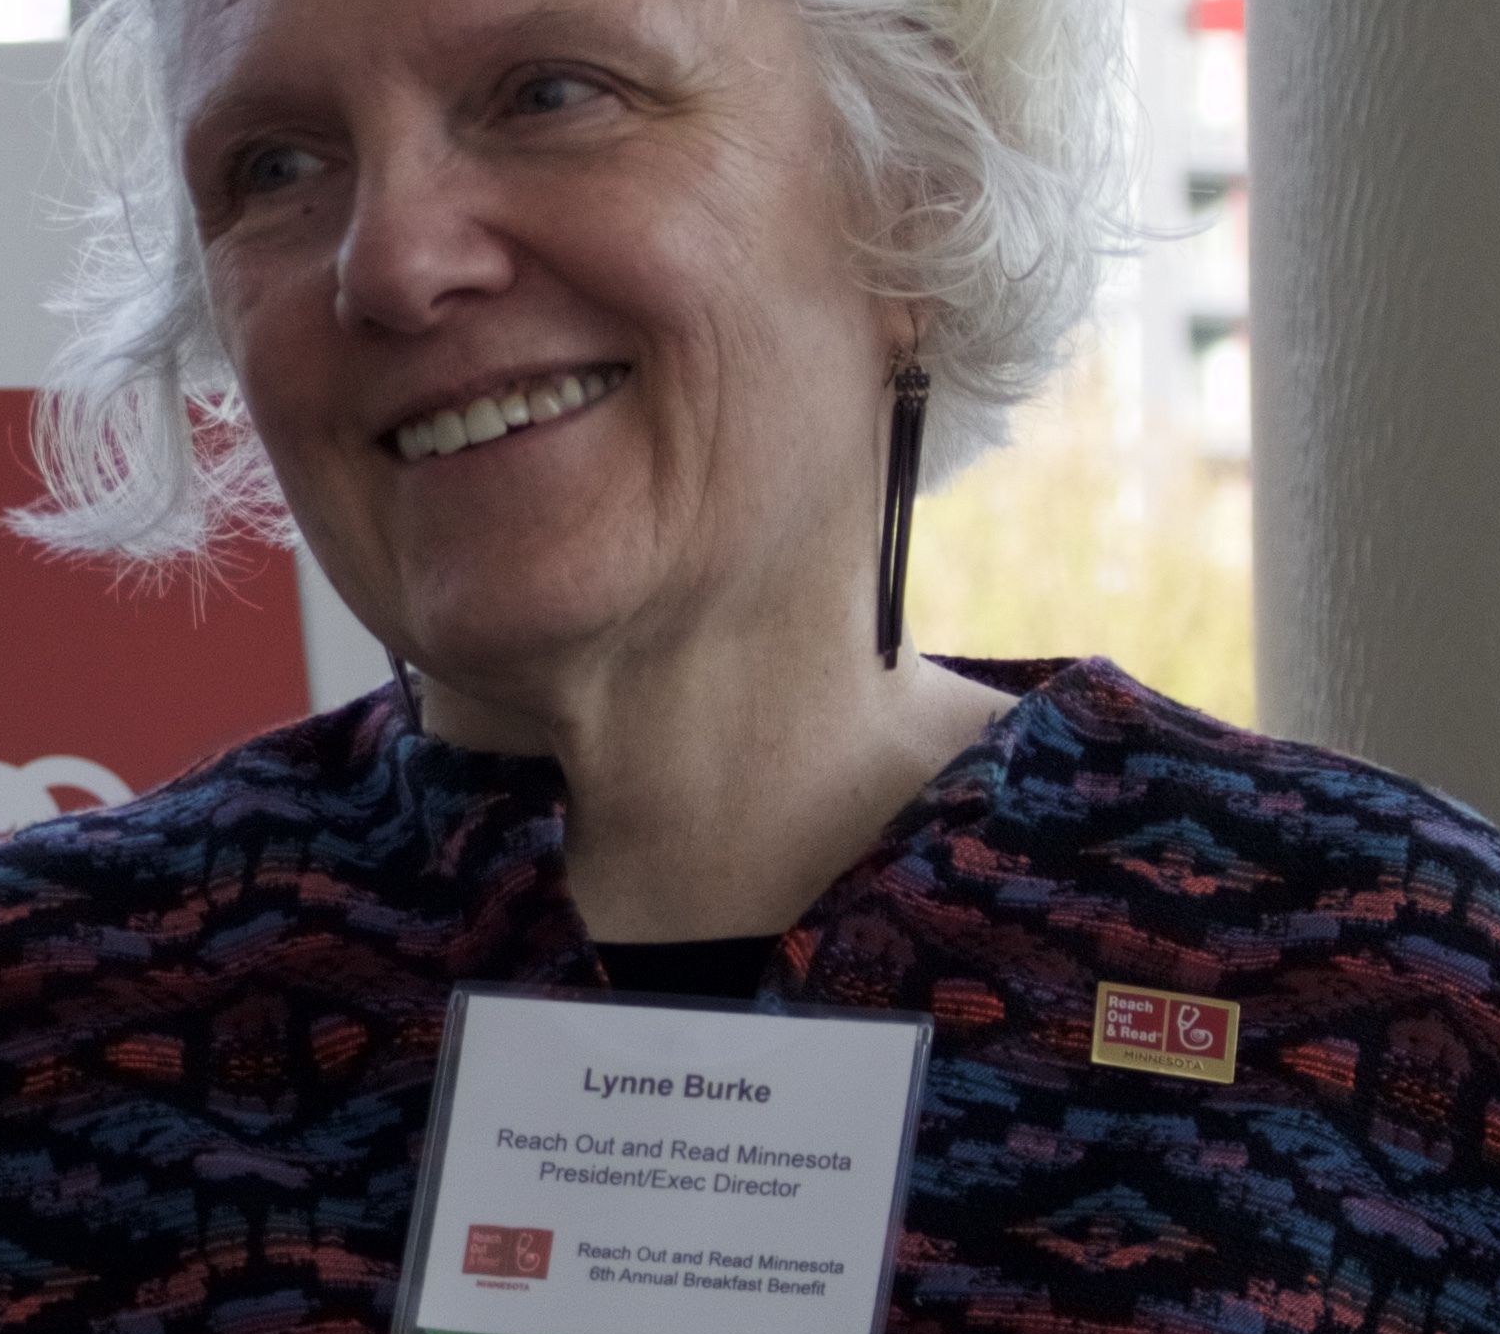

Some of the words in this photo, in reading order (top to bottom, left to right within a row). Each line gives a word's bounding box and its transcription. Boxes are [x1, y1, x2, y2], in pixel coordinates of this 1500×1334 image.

[1106, 1009, 1133, 1024] Out
[1108, 994, 1154, 1014] Reach
[1123, 1049, 1205, 1070] MINNESOTA
[582, 1067, 674, 1099] Lynne
[683, 1073, 772, 1104] Burke
[497, 1127, 568, 1152] Reach
[575, 1133, 616, 1155] Out
[621, 1139, 663, 1159] and
[670, 1139, 730, 1163] Read
[736, 1144, 853, 1172] Minnesota
[539, 1160, 707, 1193] President/Exec
[712, 1173, 802, 1198] Director
[577, 1242, 632, 1262] Reach
[636, 1246, 667, 1264] Out
[671, 1250, 704, 1266] and
[708, 1251, 754, 1269] Read
[757, 1254, 845, 1275] Minnesota
[588, 1265, 616, 1282] 6th
[618, 1267, 678, 1287] Annual
[682, 1271, 763, 1293] Breakfast
[766, 1277, 827, 1297] Benefit
